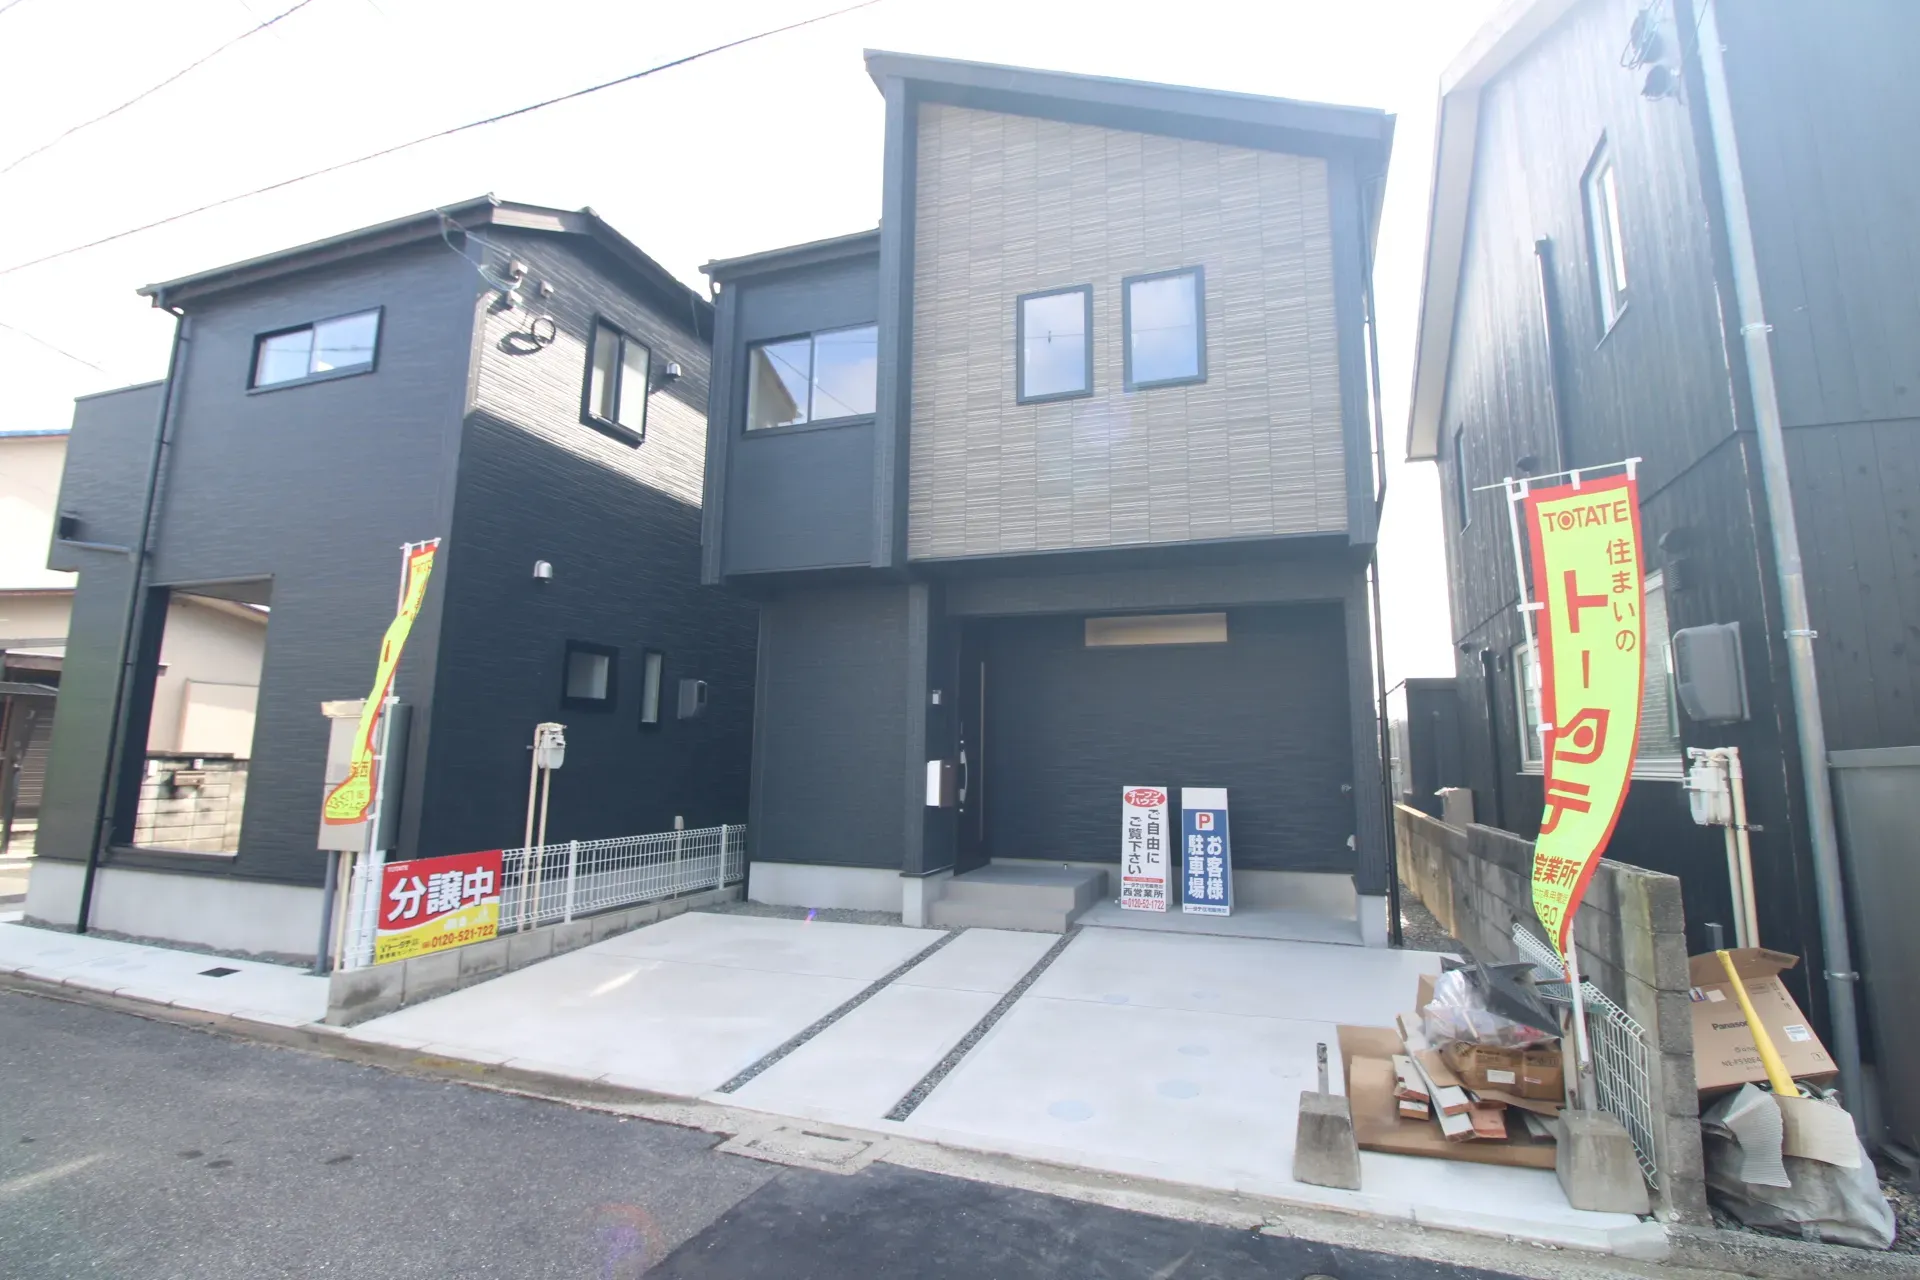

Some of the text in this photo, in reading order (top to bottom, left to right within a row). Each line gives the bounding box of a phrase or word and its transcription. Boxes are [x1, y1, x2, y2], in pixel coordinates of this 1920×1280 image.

[1542, 499, 1629, 532] TOTATE
[1606, 538, 1637, 653] 住まいの
[1540, 569, 1611, 836] トータテ
[1128, 790, 1162, 798] オープン
[1130, 797, 1160, 806] ハウス
[1146, 808, 1161, 865] ご自由に
[1198, 813, 1211, 829] P
[1127, 816, 1143, 875] ご覧下さい
[1188, 834, 1205, 899] 駐車場
[1206, 836, 1224, 900] お客様
[387, 866, 494, 922] 分譲中
[1123, 888, 1164, 898] 西営業所
[1127, 897, 1165, 910] 0120-52-1722
[431, 923, 495, 948] 0120-521-722
